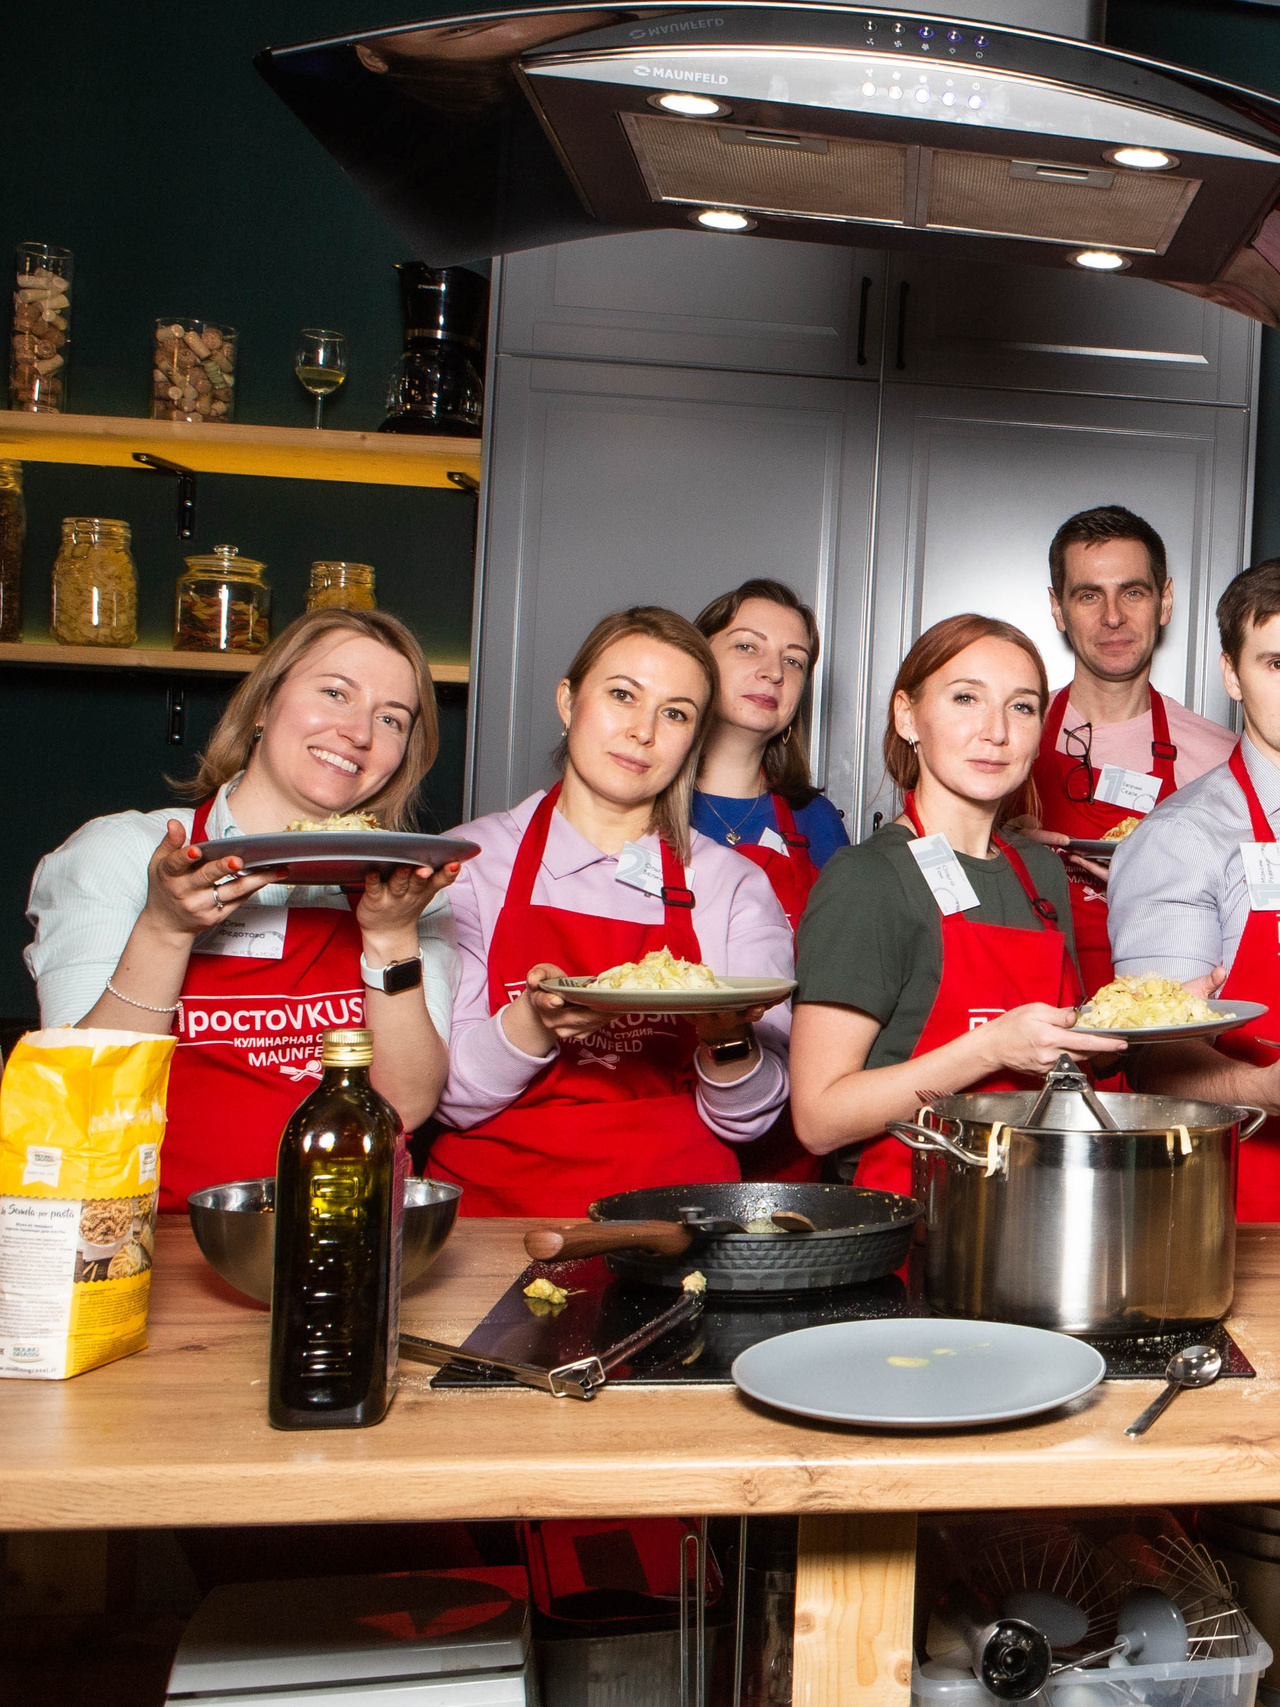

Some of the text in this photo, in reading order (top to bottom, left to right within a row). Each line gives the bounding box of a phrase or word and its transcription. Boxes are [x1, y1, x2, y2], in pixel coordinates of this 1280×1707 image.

[653, 66, 729, 86] MAUNFELD
[615, 842, 652, 890] 2
[179, 997, 364, 1038] ростоVKUS
[234, 1034, 313, 1048] КУЛИНАРНАЯ
[613, 1027, 654, 1039] СТУДИЯ
[248, 1046, 323, 1067] MAUNFE
[50, 1208, 75, 1220] pasta
